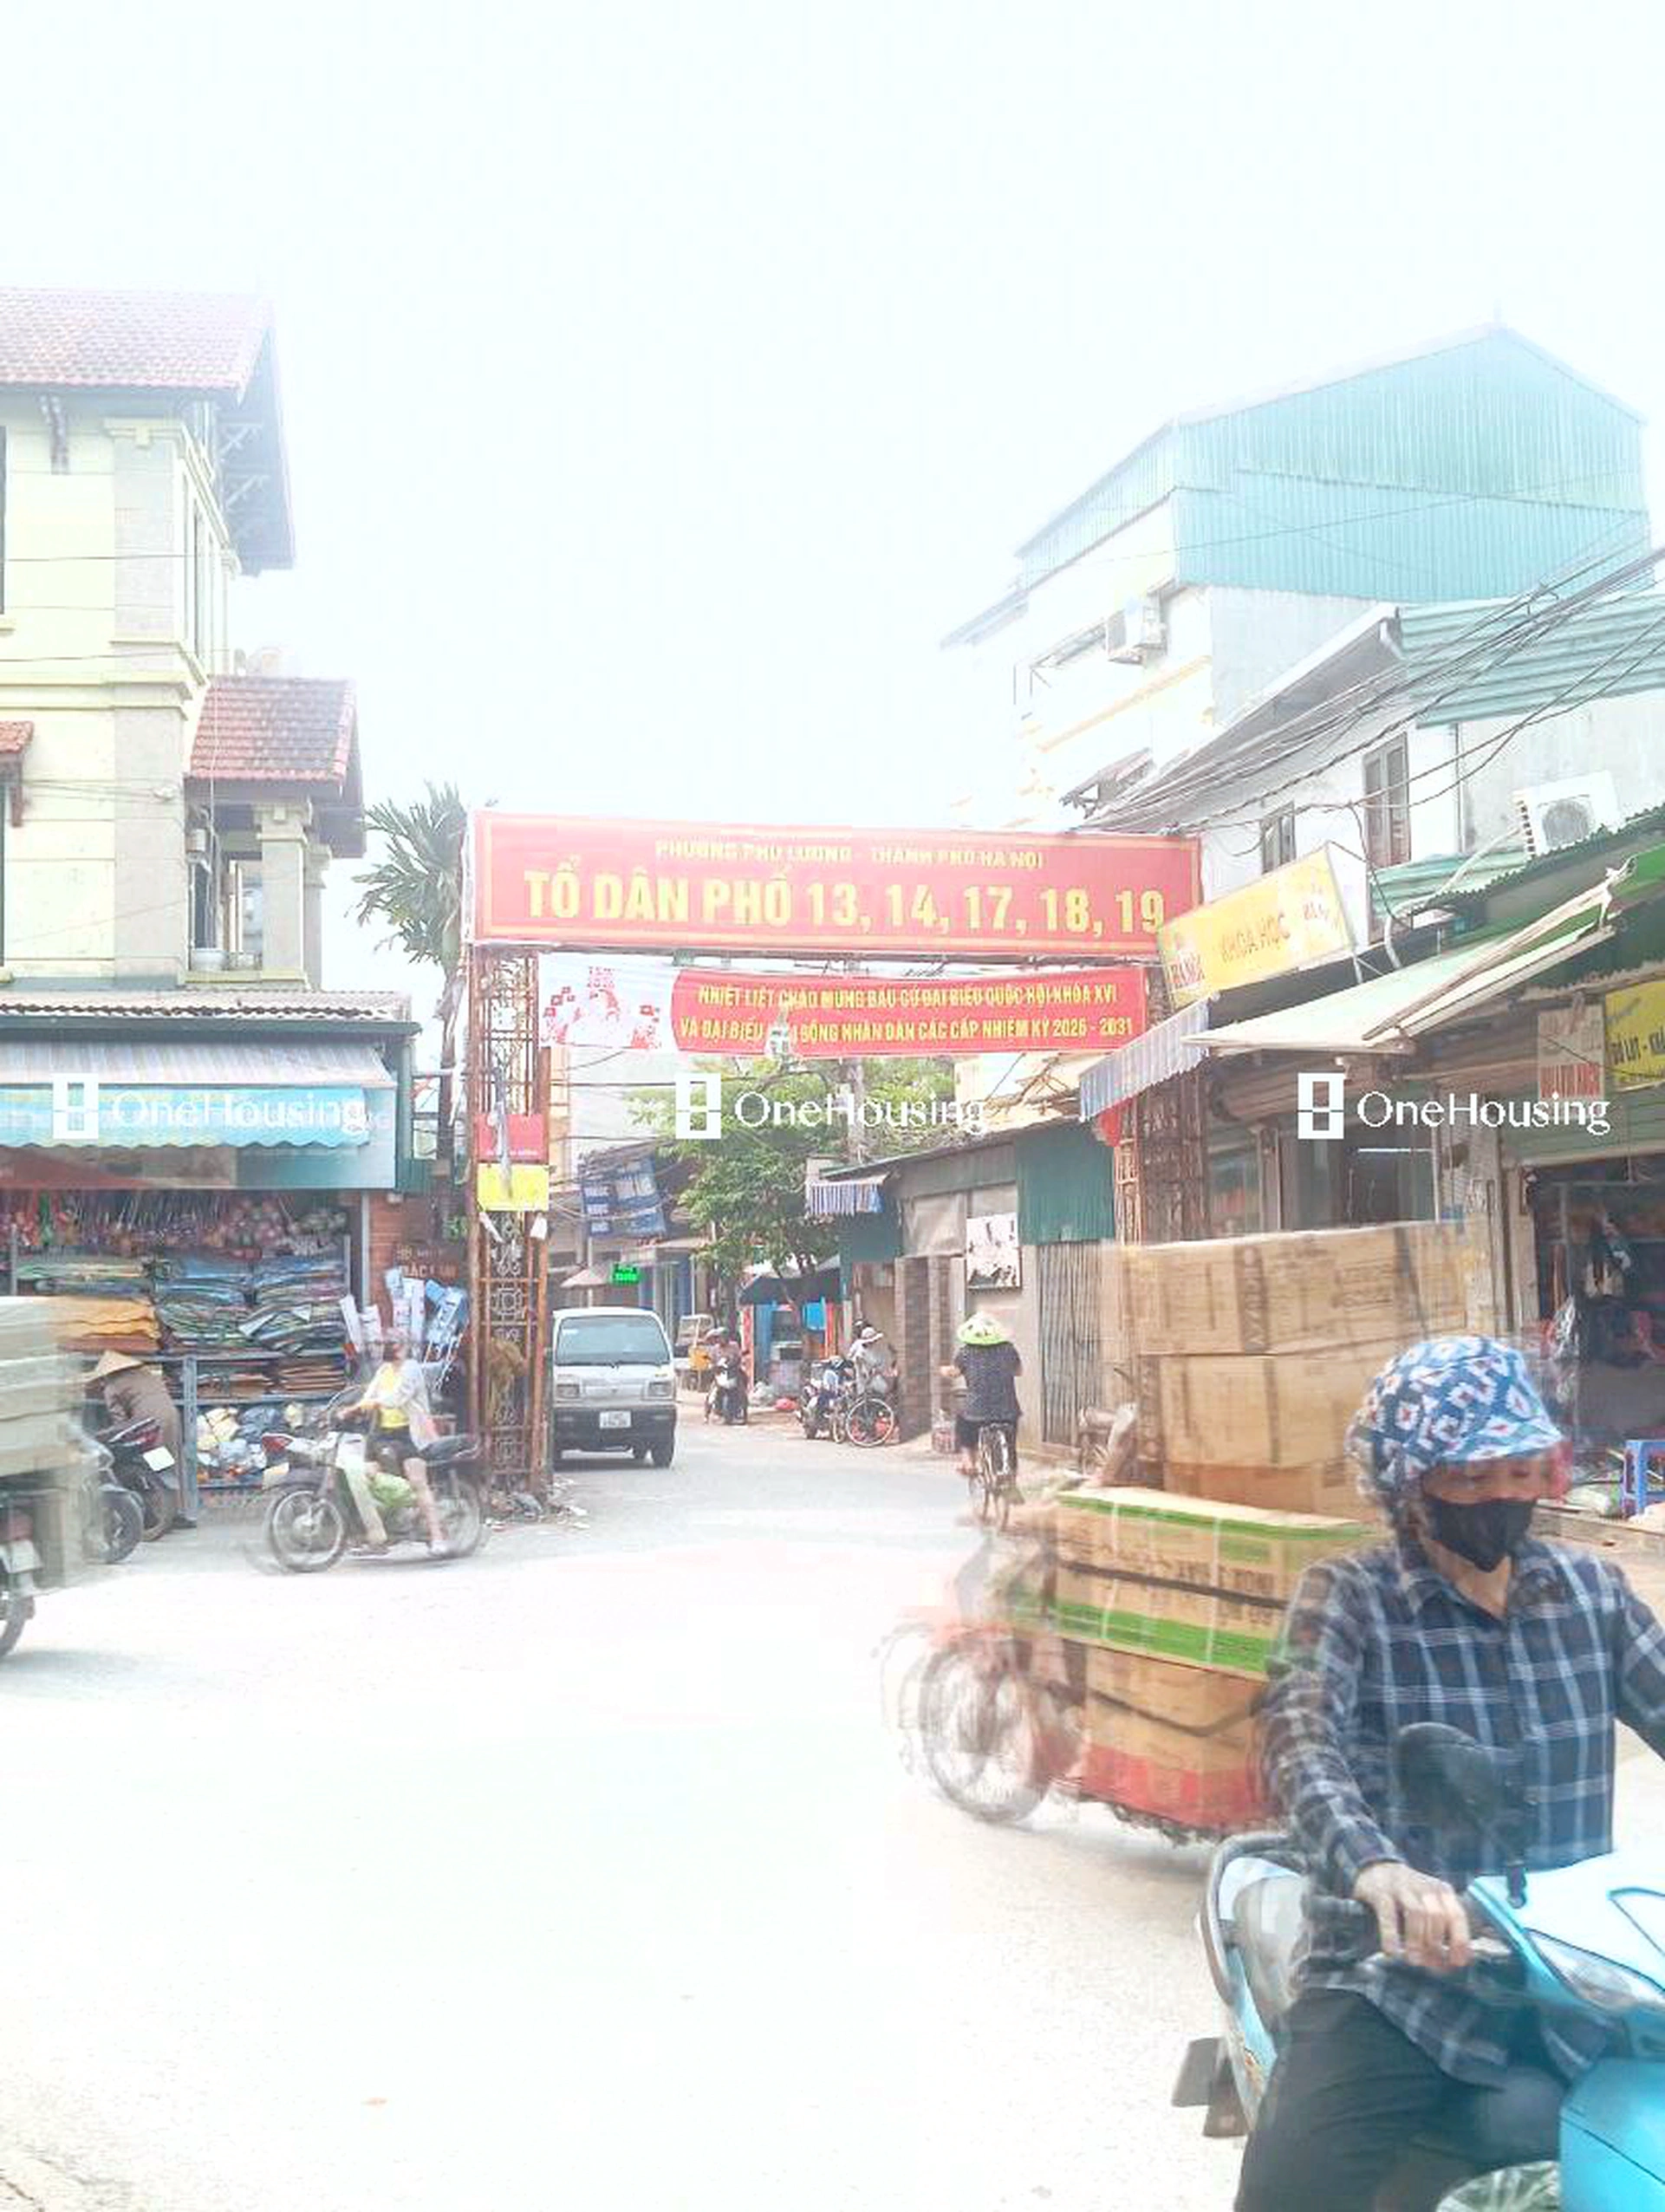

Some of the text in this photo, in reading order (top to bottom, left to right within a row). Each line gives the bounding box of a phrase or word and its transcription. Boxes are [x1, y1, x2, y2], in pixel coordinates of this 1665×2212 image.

[524, 854, 1165, 938] TỔ DÂN PHỐ 13, 14, 17, 18, 19
[1051, 1018, 1088, 1038] 2026
[1098, 1016, 1134, 1036] 2031
